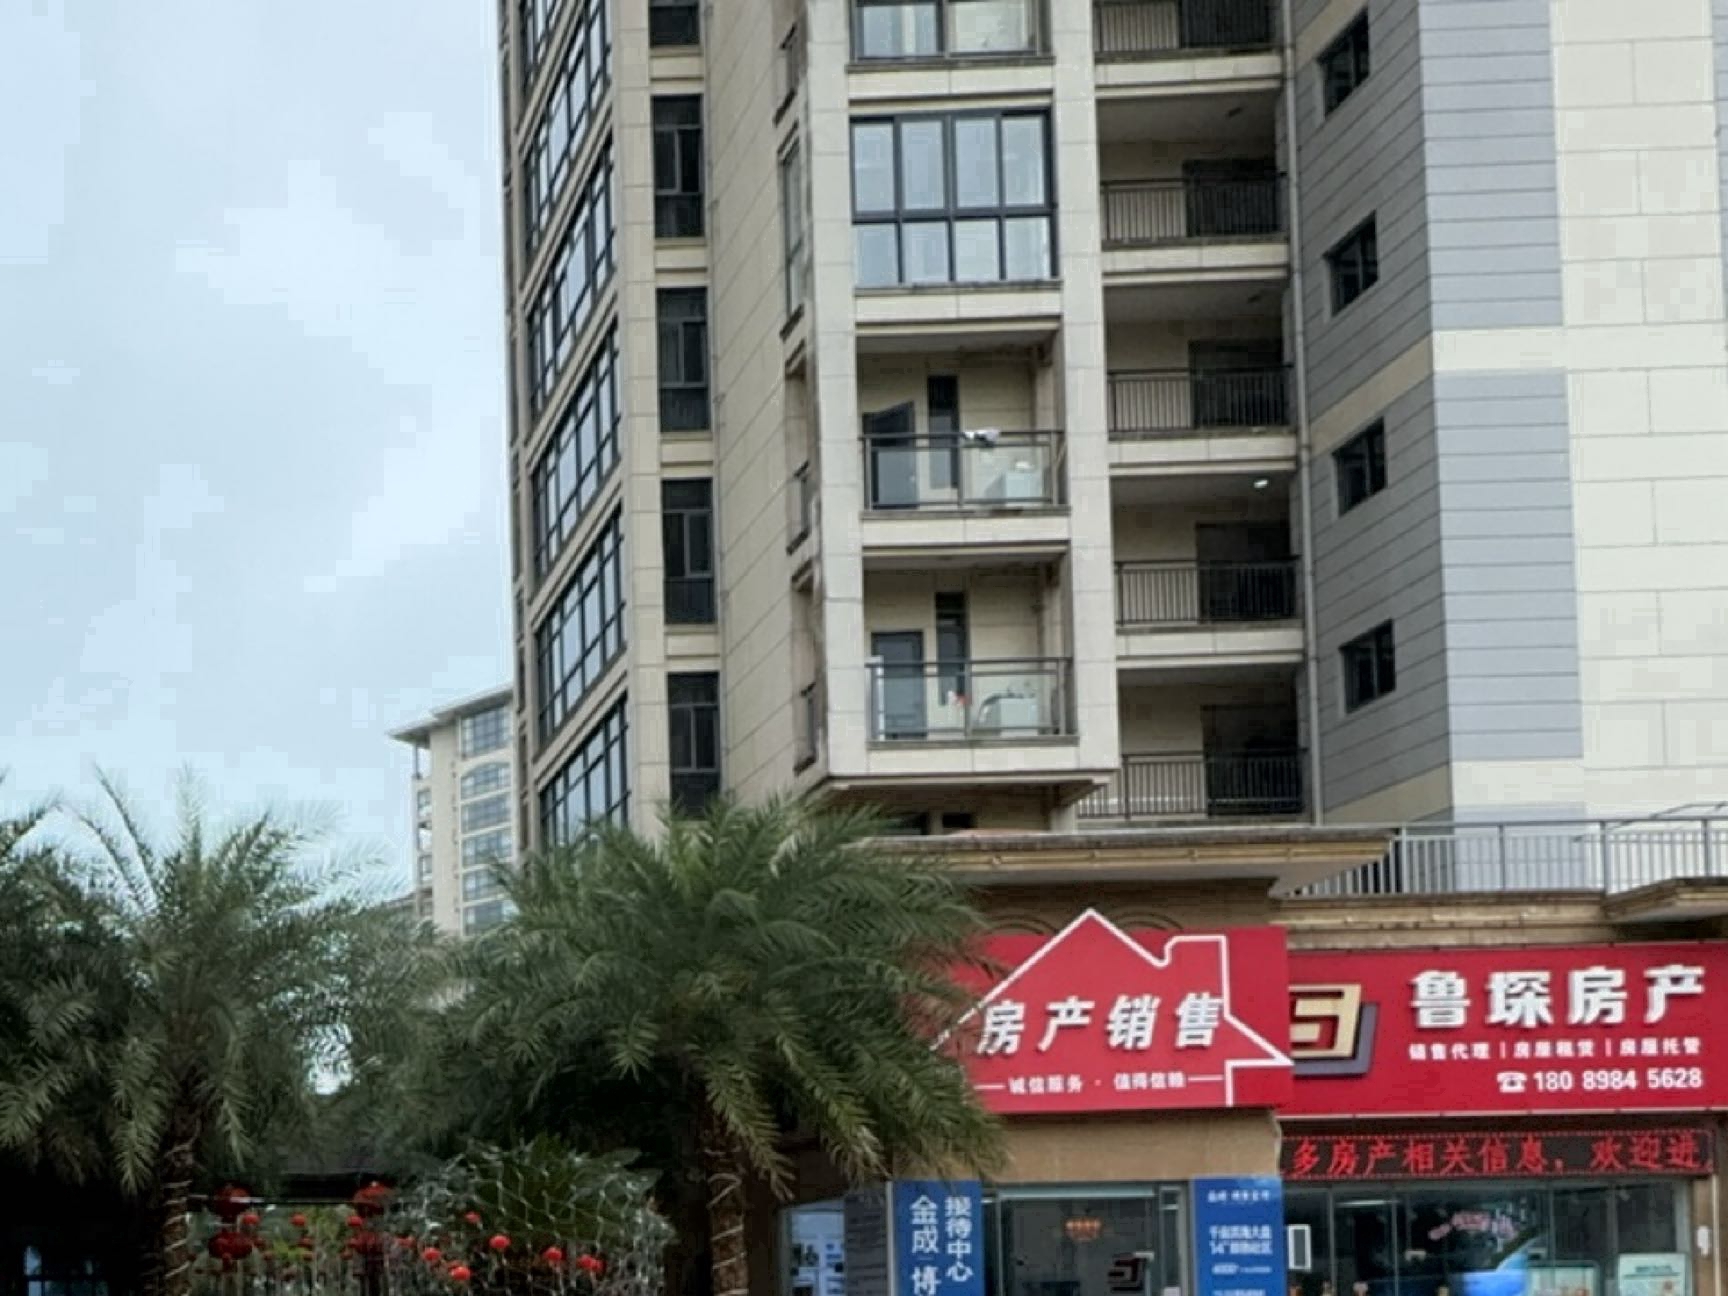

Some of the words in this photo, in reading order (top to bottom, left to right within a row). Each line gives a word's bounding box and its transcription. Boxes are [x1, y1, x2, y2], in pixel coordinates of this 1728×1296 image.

[977, 992, 1225, 1055] 房产销售
[1410, 965, 1705, 1029] 鲁琛房产
[1533, 1071, 1573, 1091] 180
[1582, 1069, 1638, 1090] 8984
[1647, 1067, 1703, 1089] 5628
[944, 1196, 974, 1281] 接待中心
